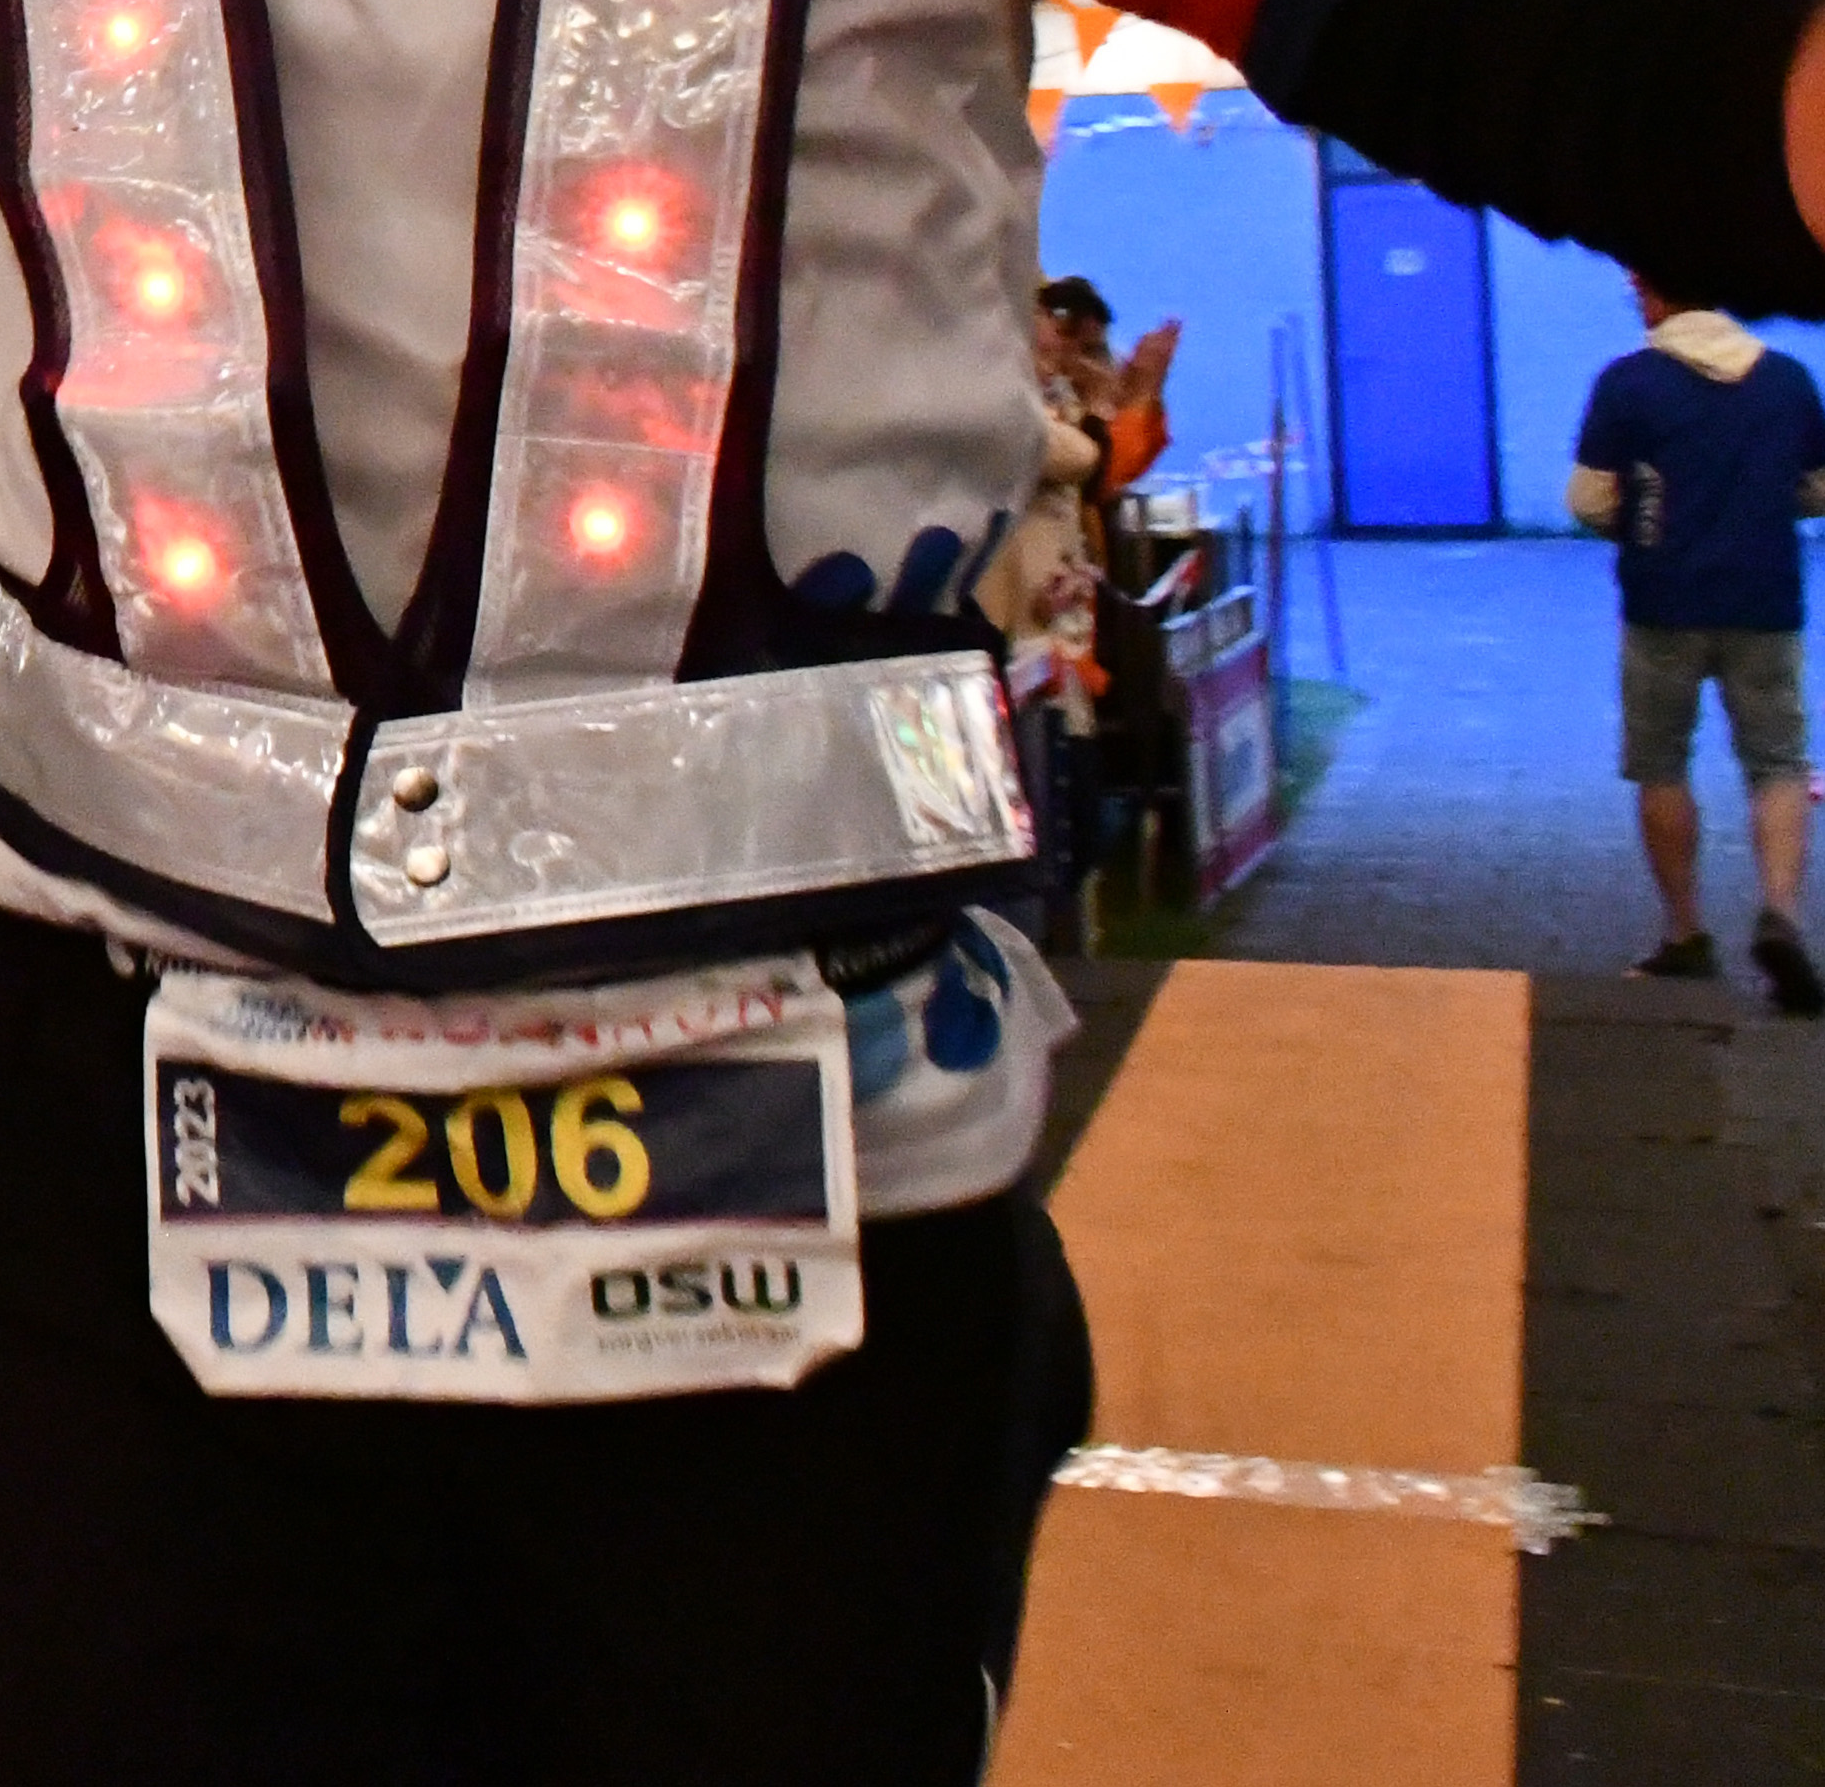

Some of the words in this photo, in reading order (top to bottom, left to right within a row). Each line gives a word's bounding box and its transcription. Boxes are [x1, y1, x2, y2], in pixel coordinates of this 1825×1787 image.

[174, 1078, 220, 1207] 2023
[340, 1078, 650, 1219] 206
[206, 1258, 527, 1361] DELA
